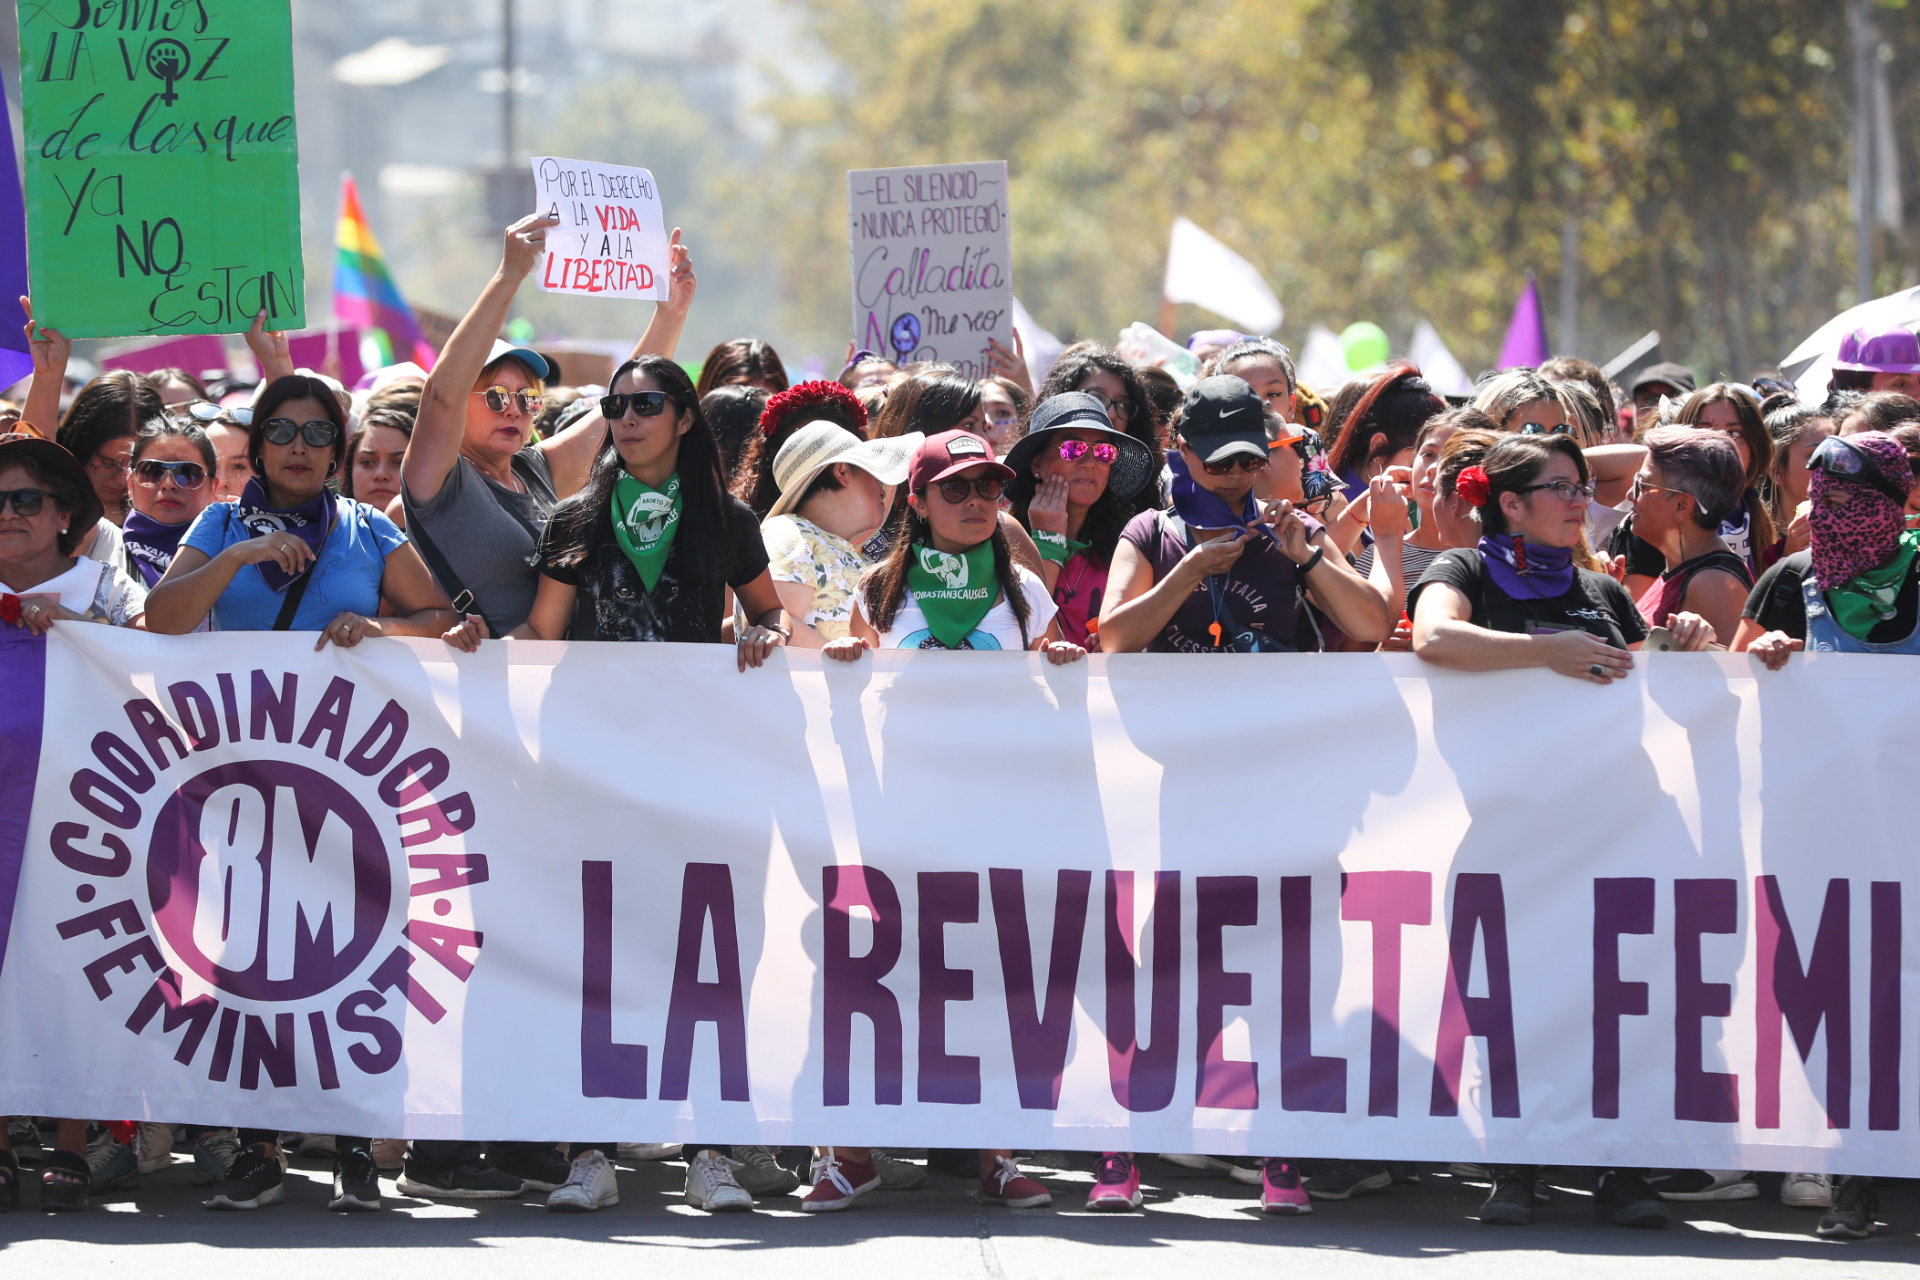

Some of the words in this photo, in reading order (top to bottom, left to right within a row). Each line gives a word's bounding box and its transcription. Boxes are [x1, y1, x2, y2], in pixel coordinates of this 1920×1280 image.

[37, 31, 97, 84] LA
[41, 93, 105, 160] de
[540, 158, 579, 198] POR
[581, 168, 596, 197] EL
[598, 173, 653, 200] DERECHO
[876, 176, 898, 205] EL
[904, 170, 978, 203] SILENCIO
[547, 201, 561, 223] A
[572, 201, 590, 226] LA
[595, 205, 641, 233] VIDA
[861, 210, 916, 239] NUNCA
[115, 216, 184, 278] NO
[543, 252, 654, 292] LIBERTAD
[580, 233, 590, 256] Y
[600, 234, 611, 257] A
[617, 233, 633, 260] LA
[857, 246, 1004, 309] Calladita
[50, 669, 489, 897] COORDINADORA
[192, 782, 356, 982] 8M
[56, 898, 484, 1091] FEMINISTA
[581, 860, 750, 1102] LA
[822, 864, 1522, 1118] REVUELTA
[1592, 874, 1920, 1131] FEMI
